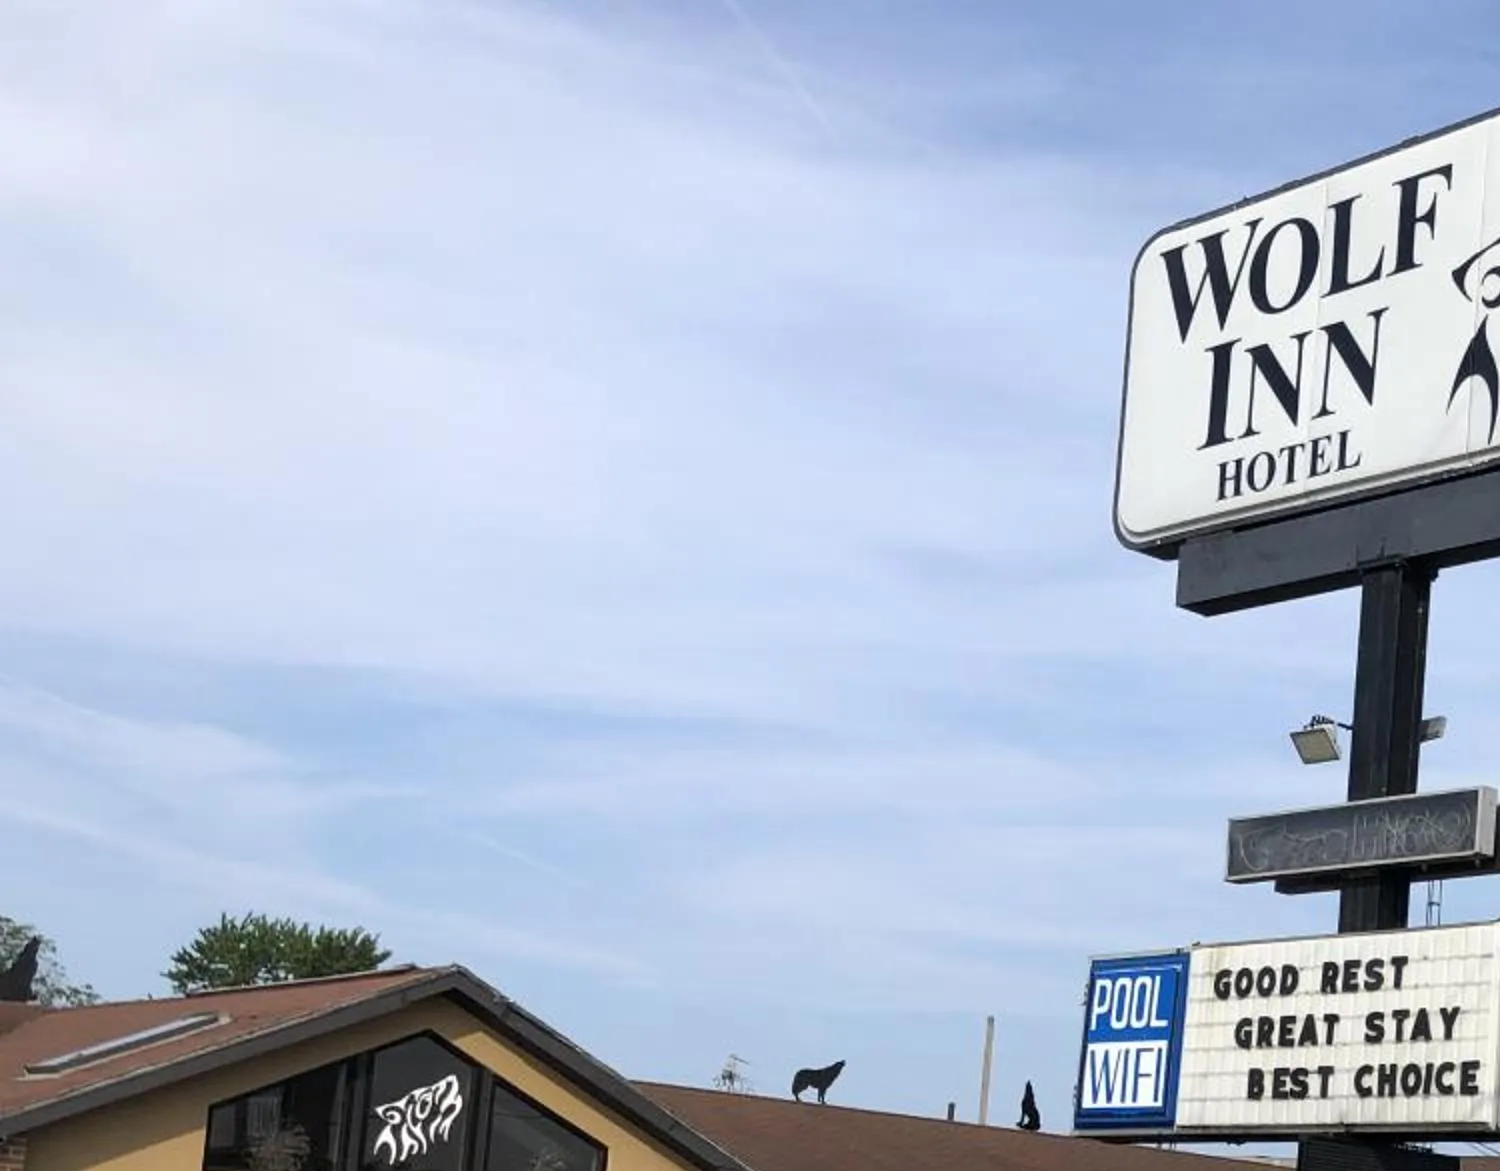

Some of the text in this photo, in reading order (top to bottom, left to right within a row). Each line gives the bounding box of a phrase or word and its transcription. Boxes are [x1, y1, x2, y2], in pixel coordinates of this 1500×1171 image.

[1160, 163, 1453, 344] WOLF
[1197, 307, 1389, 450] INN
[1216, 430, 1362, 500] HOTEL
[1090, 975, 1168, 1031] POOL
[1214, 956, 1408, 999] GOOD REST
[1234, 1006, 1461, 1049] GREAT STAY
[1090, 1047, 1163, 1104] WIFI
[1247, 1060, 1480, 1101] BEST CHOICE
